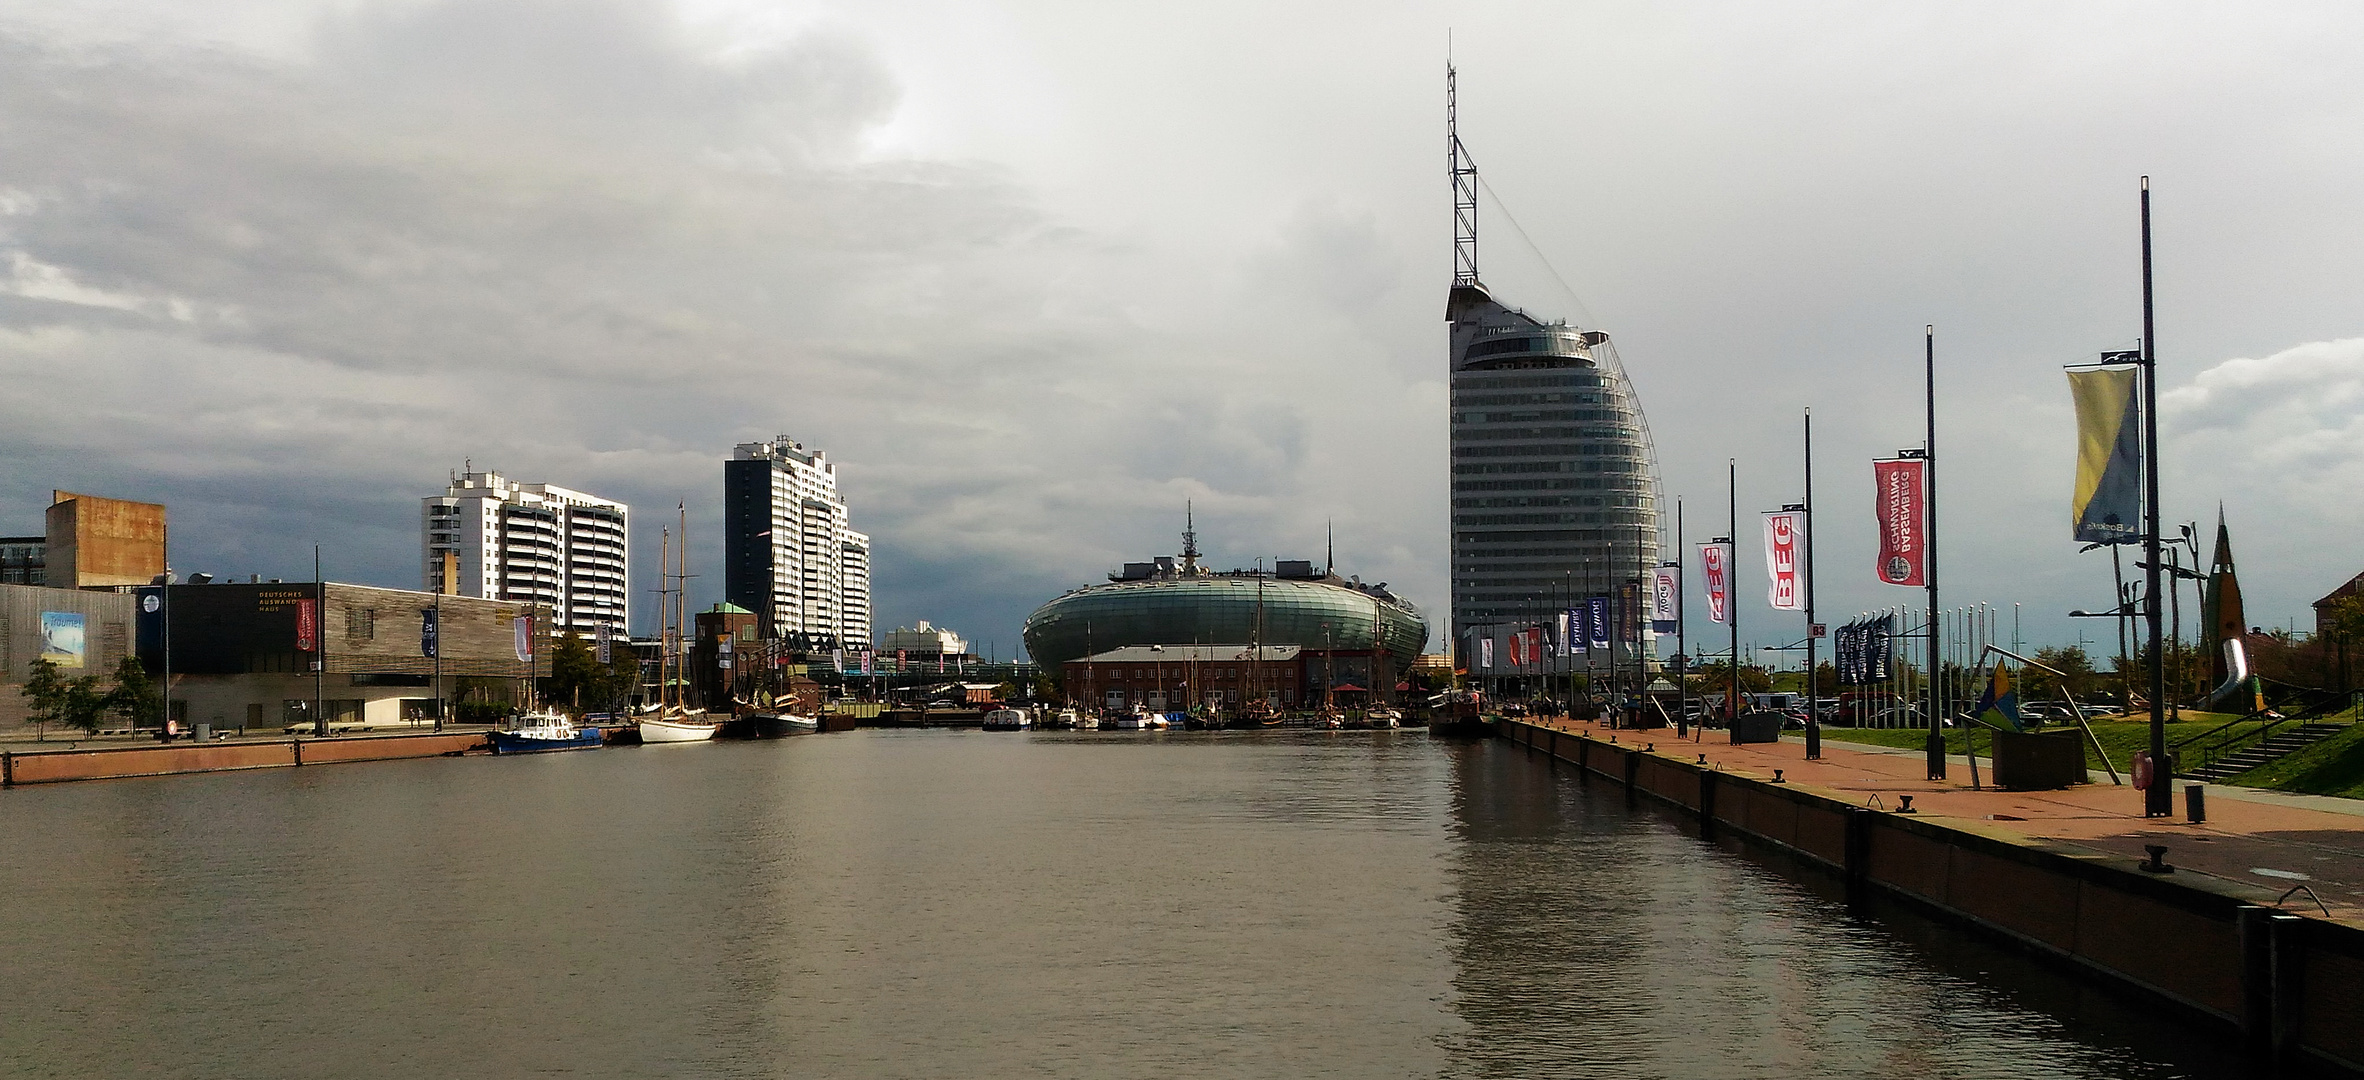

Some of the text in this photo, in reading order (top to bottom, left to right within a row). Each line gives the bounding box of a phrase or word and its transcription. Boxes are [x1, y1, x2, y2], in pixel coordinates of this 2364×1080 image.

[1704, 548, 1724, 620] BEG
[1774, 517, 1793, 606] BEG
[1812, 626, 1825, 637] B3
